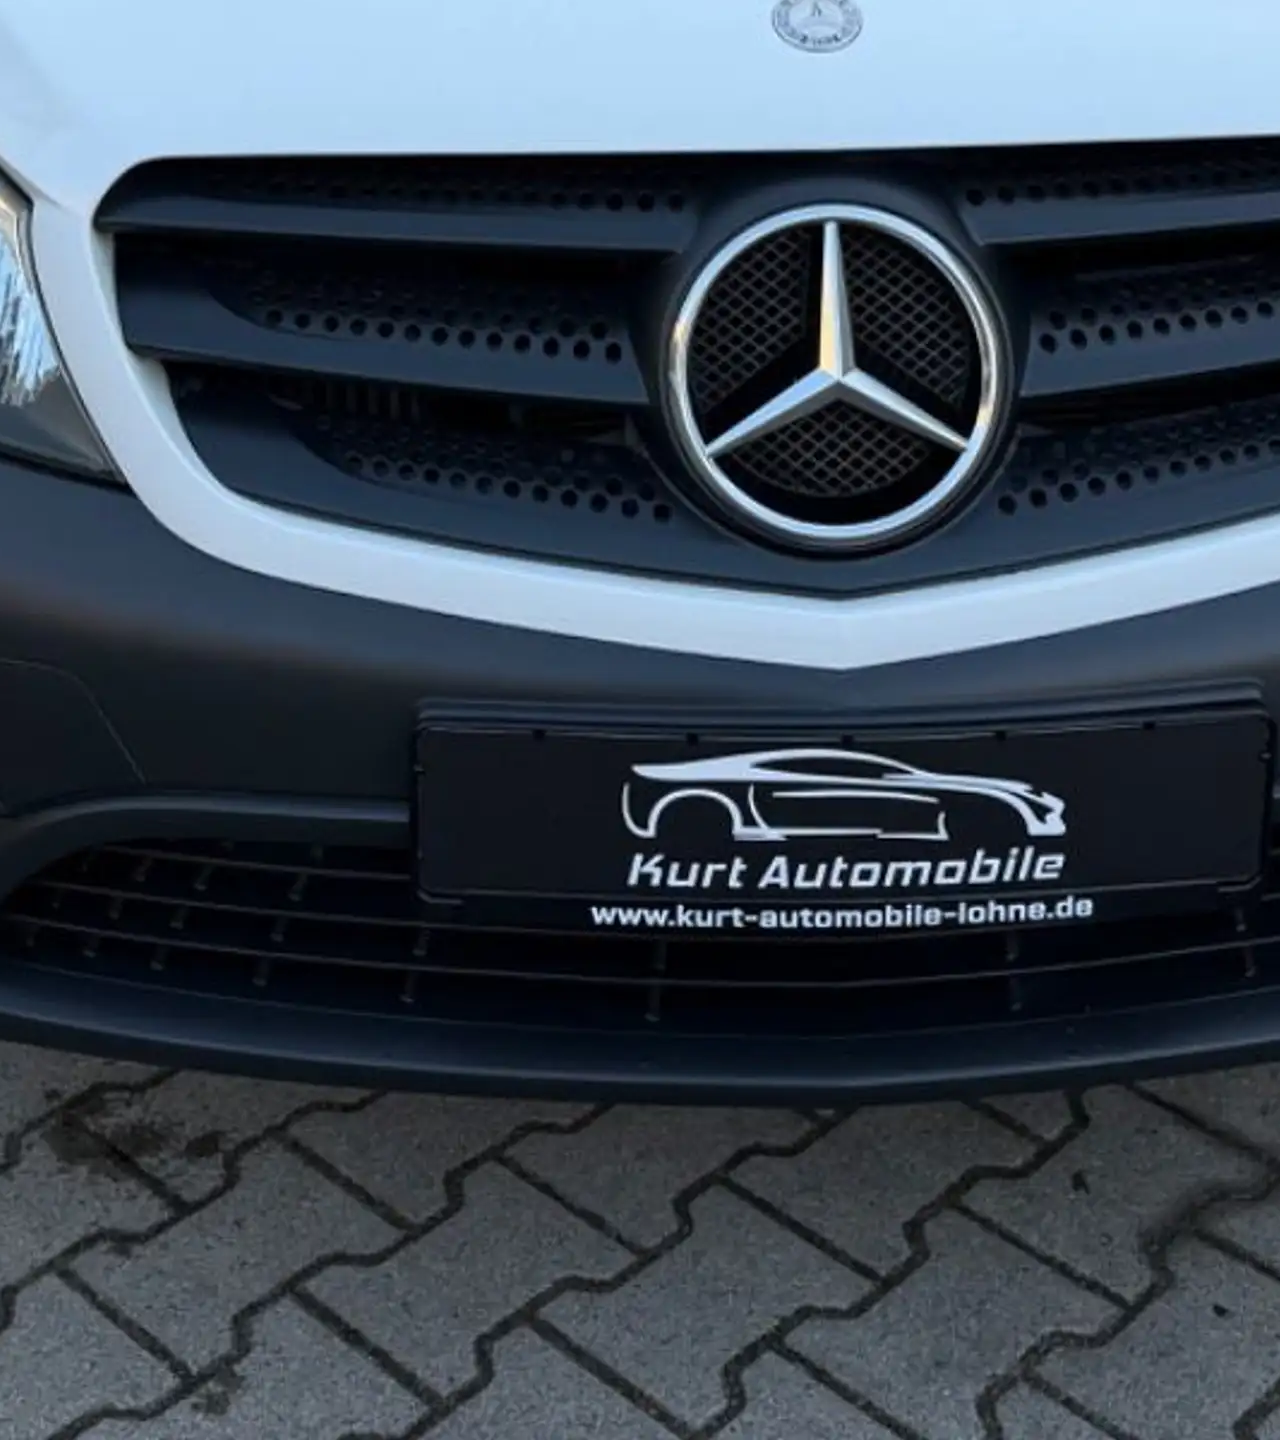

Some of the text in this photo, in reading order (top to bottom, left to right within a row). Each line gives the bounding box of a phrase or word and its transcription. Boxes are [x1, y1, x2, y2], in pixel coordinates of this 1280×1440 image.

[626, 845, 1065, 889] Kurt Automobile
[589, 894, 1094, 929] www.kurt-automobile-lohne.de
